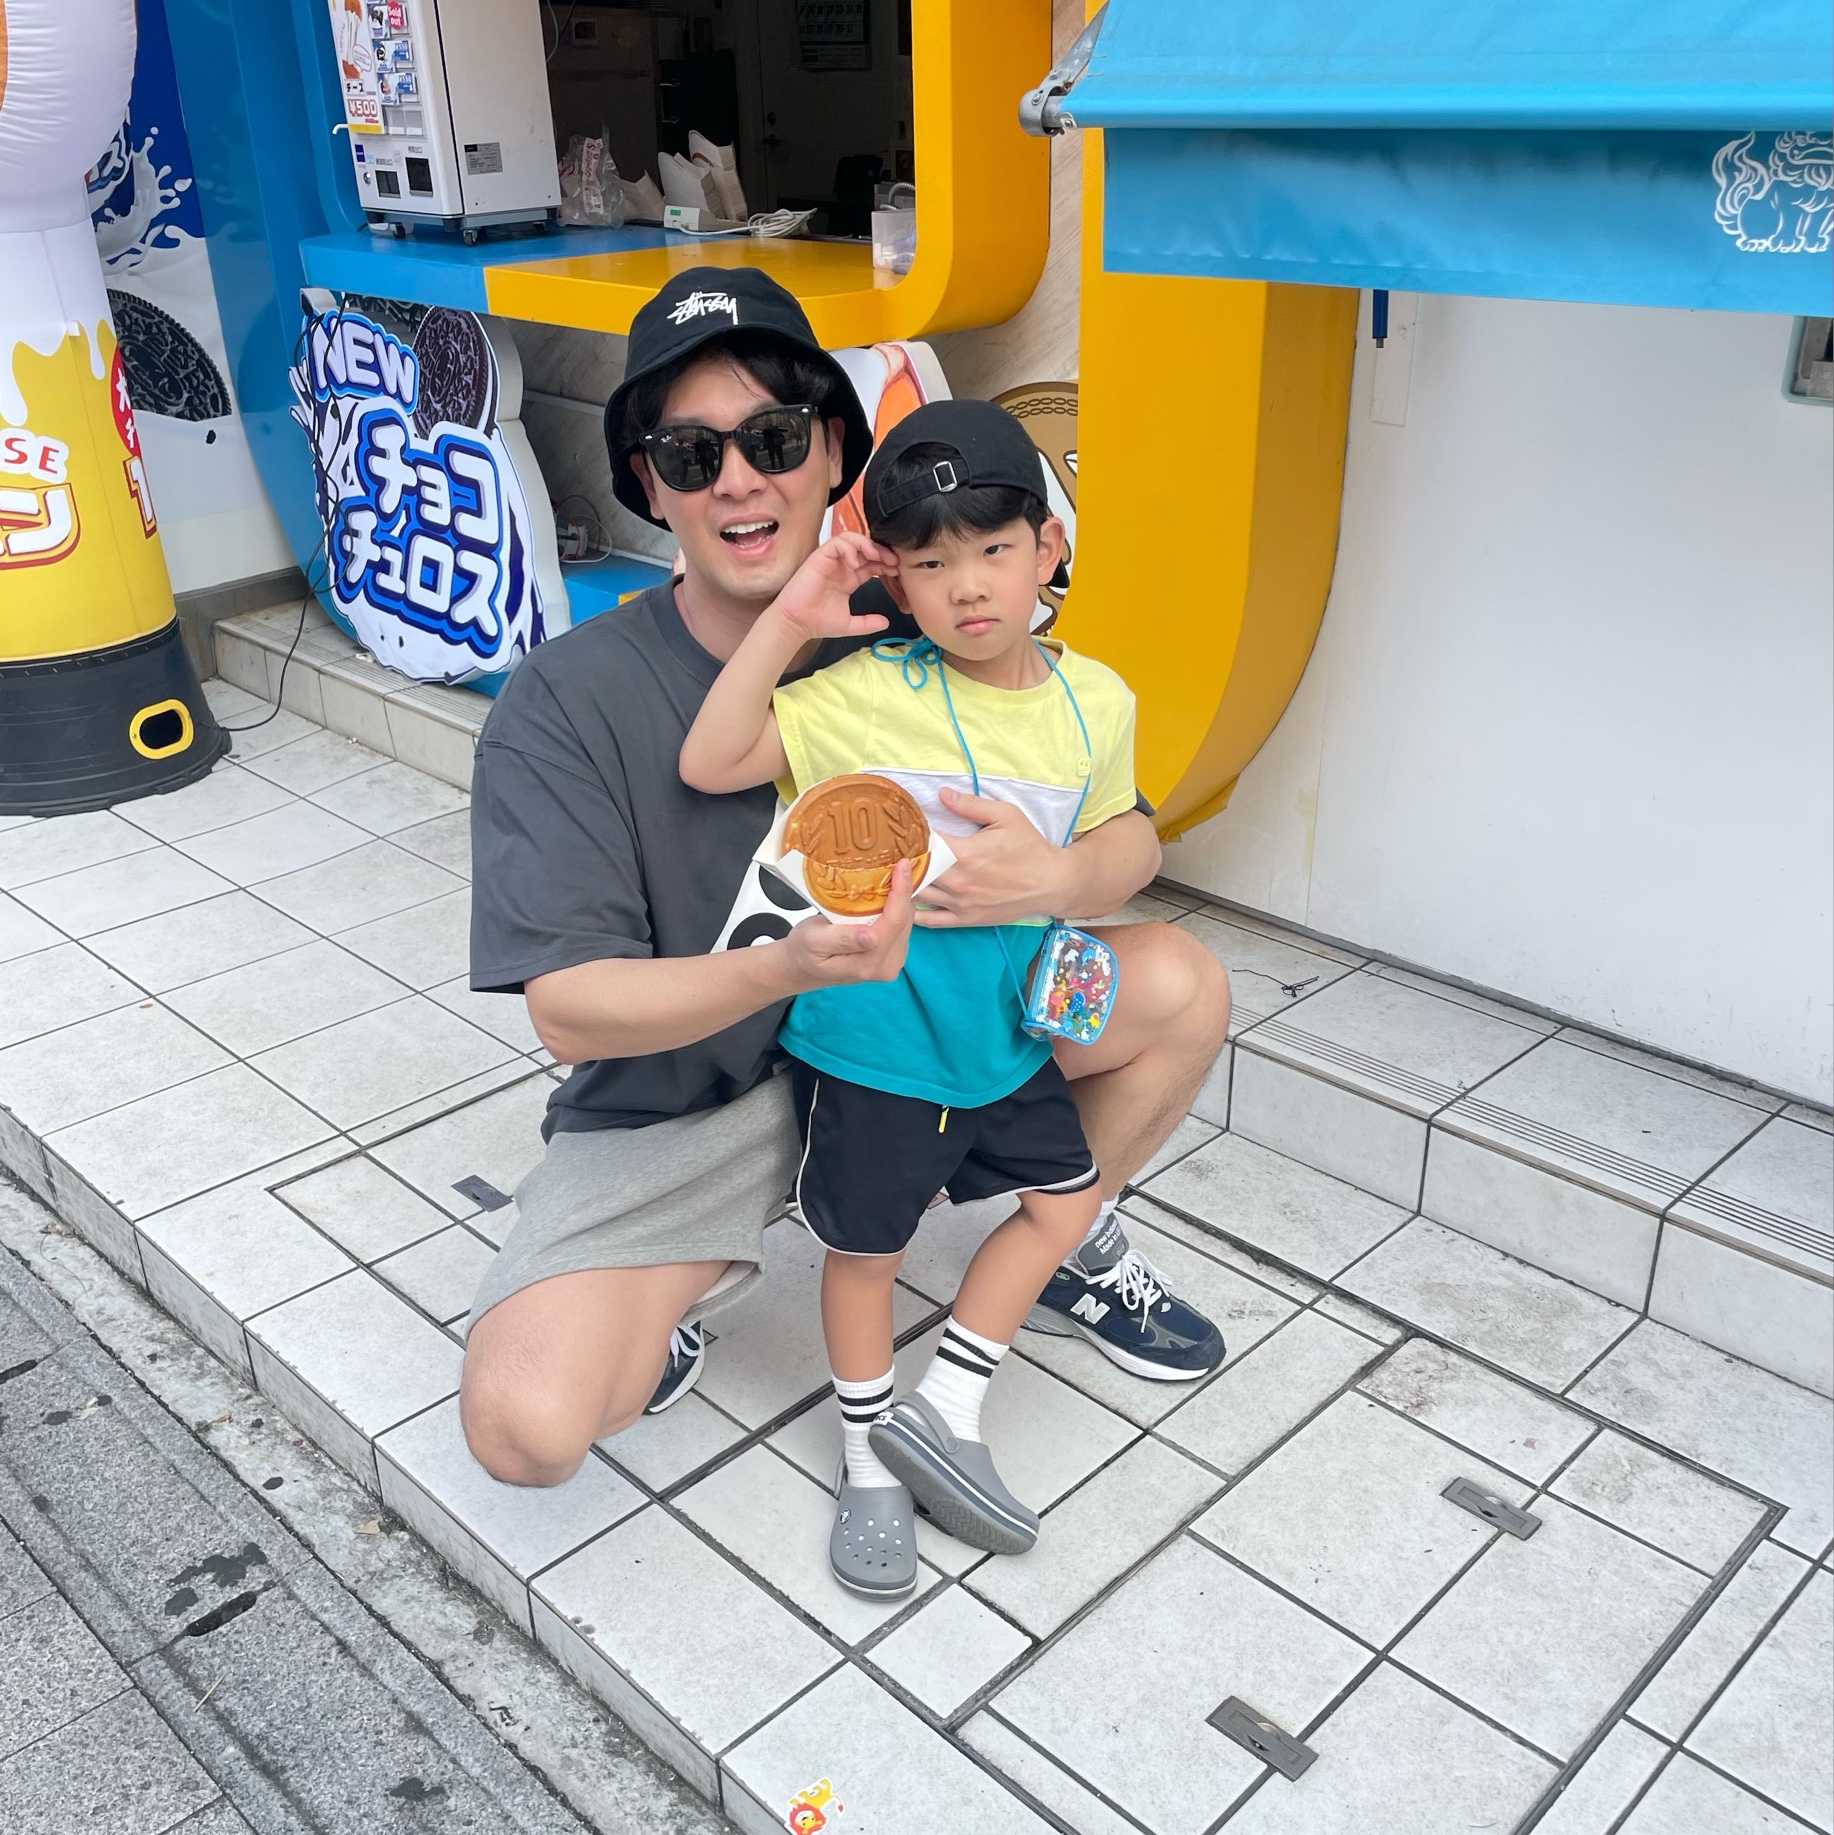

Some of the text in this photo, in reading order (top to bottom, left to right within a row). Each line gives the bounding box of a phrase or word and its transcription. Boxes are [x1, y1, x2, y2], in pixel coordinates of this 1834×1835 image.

[348, 99, 378, 117] ¥500
[309, 317, 415, 404] NEW
[369, 423, 499, 545] チョコ
[343, 509, 499, 637] チュロス
[827, 796, 878, 855] 10
[1070, 1292, 1111, 1325] N
